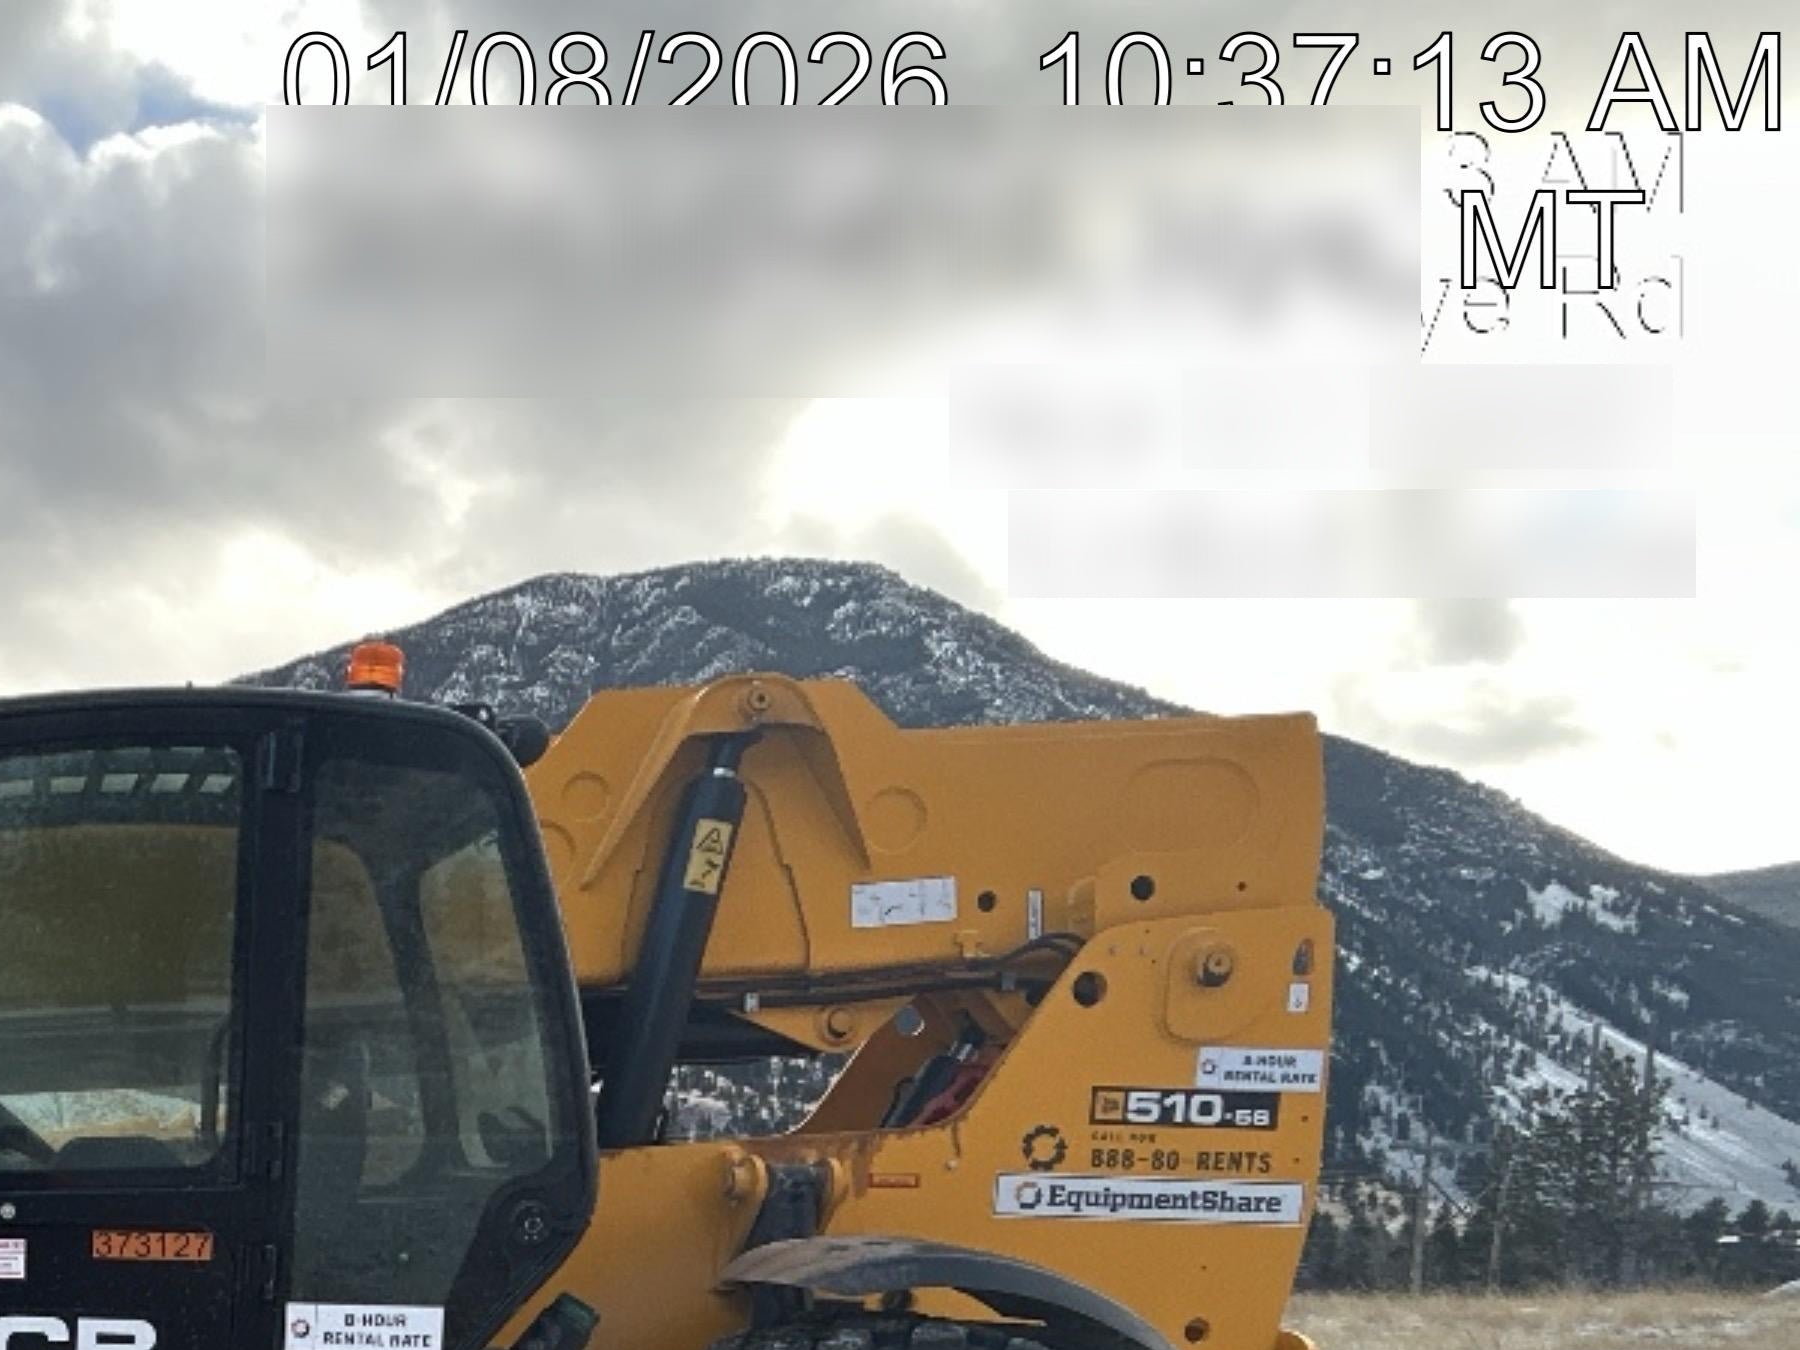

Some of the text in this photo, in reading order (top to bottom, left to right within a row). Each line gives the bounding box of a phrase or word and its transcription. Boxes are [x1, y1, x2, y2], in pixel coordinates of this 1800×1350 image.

[1046, 1183, 1283, 1213] EquipmentShare
[95, 1232, 211, 1258] 373127
[323, 1332, 433, 1349] RENTAL RATE
